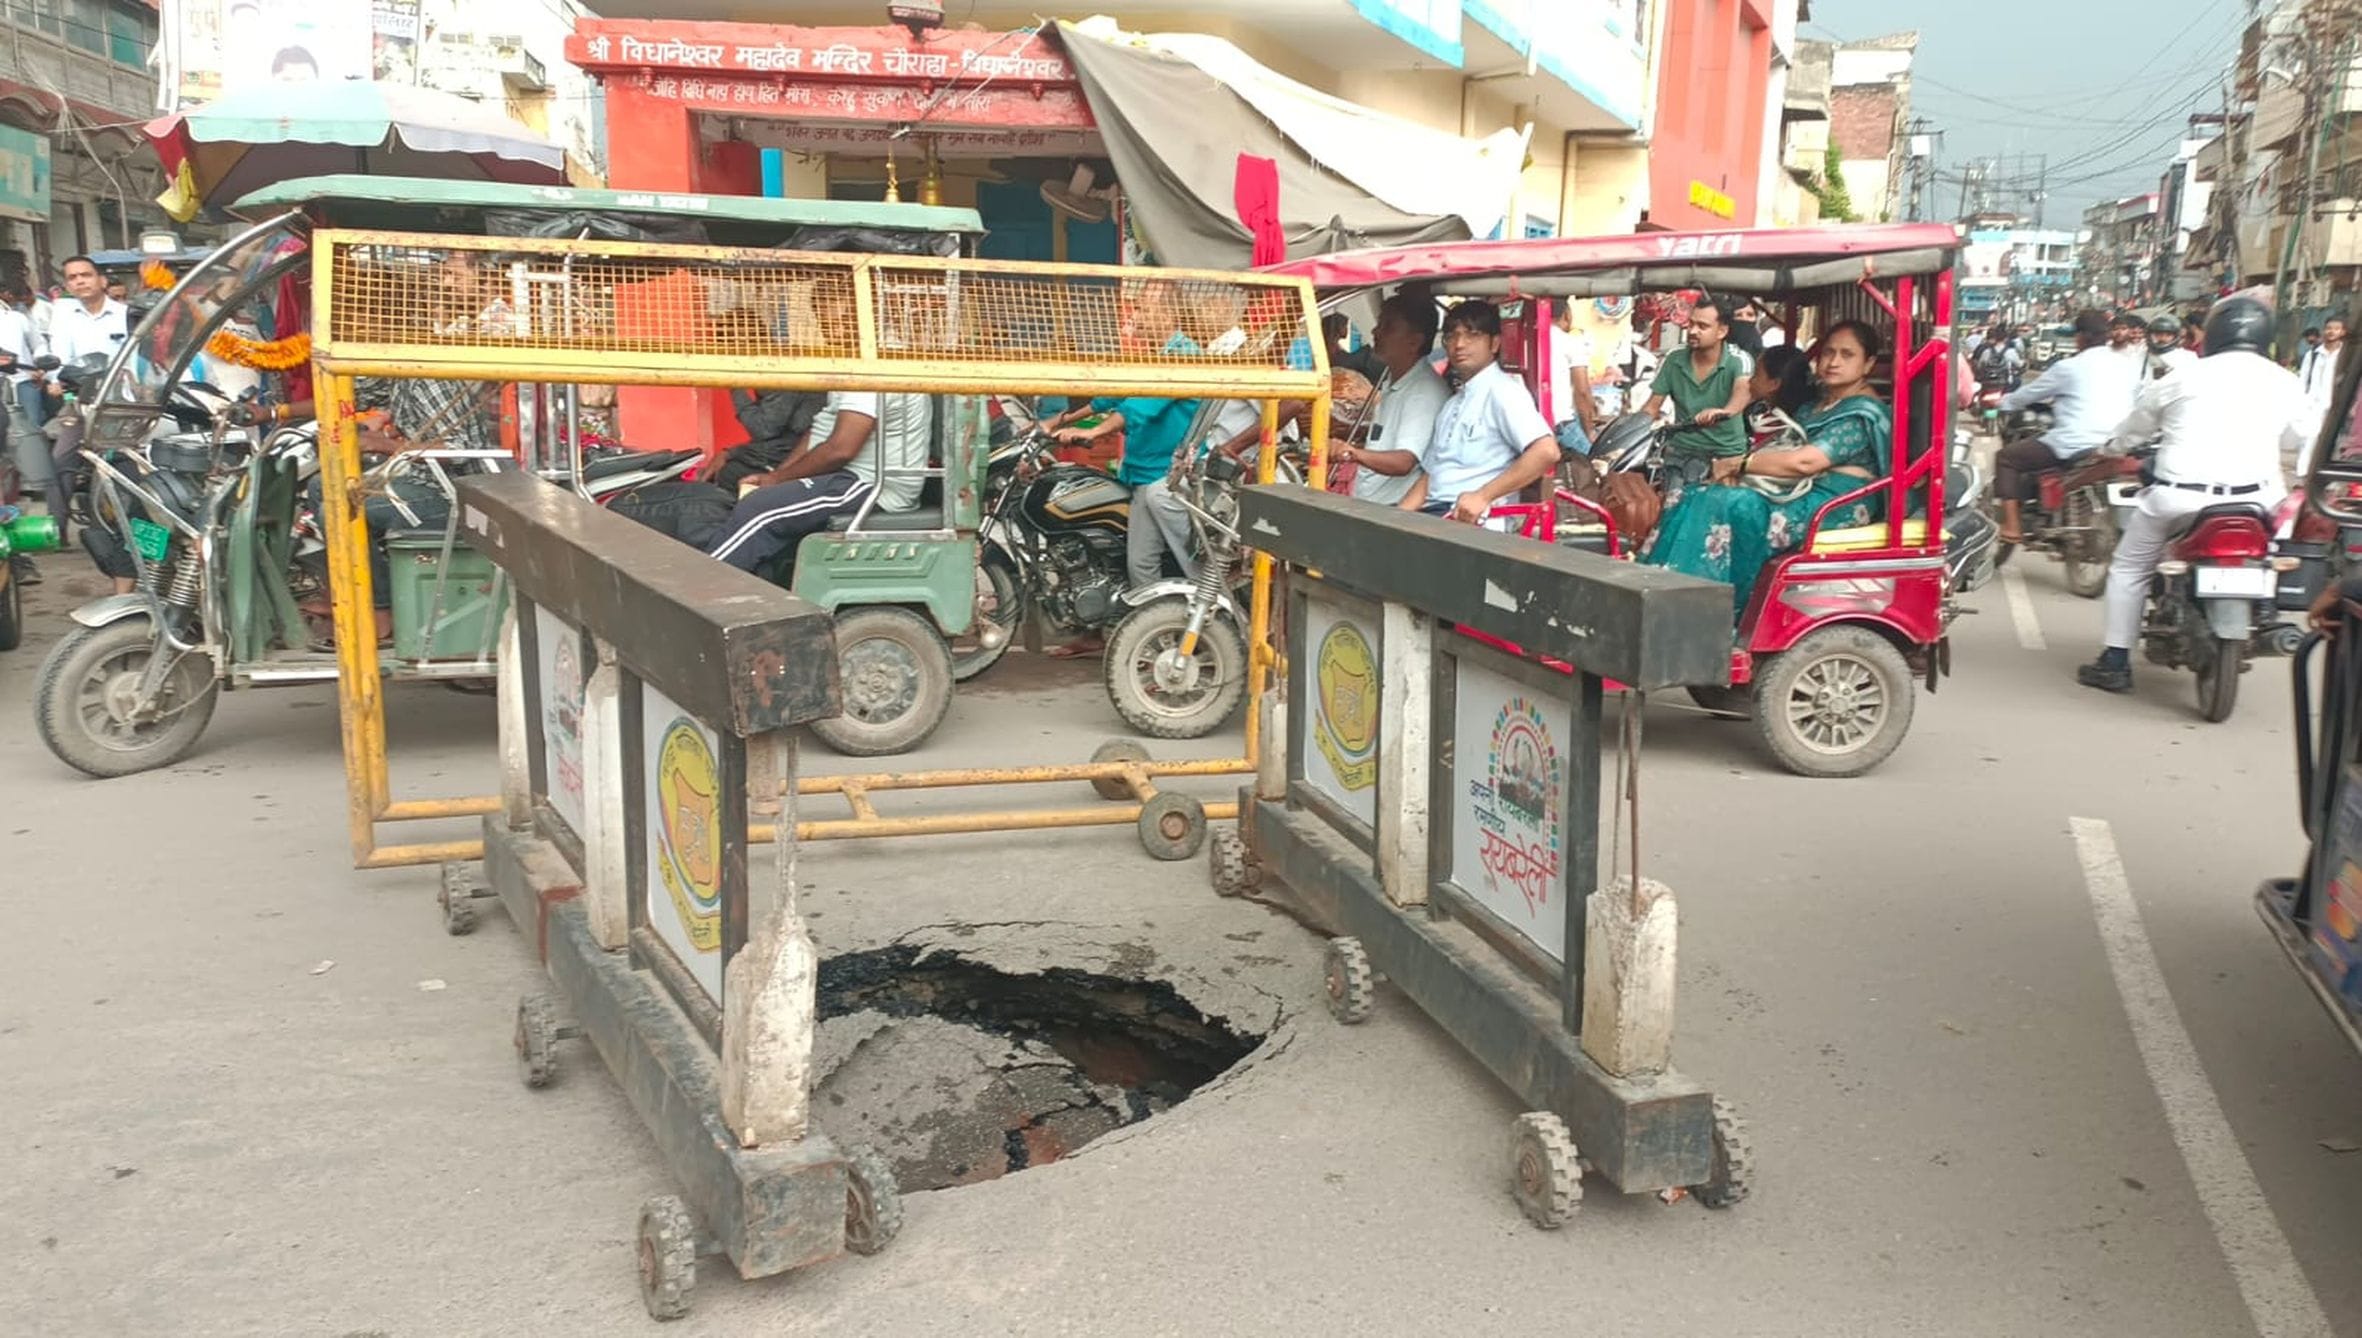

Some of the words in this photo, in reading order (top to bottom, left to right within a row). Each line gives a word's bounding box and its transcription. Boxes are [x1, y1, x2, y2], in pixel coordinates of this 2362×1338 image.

[587, 36, 612, 62] श्री
[735, 43, 802, 71] महादेव
[812, 44, 873, 75] मन्दिर
